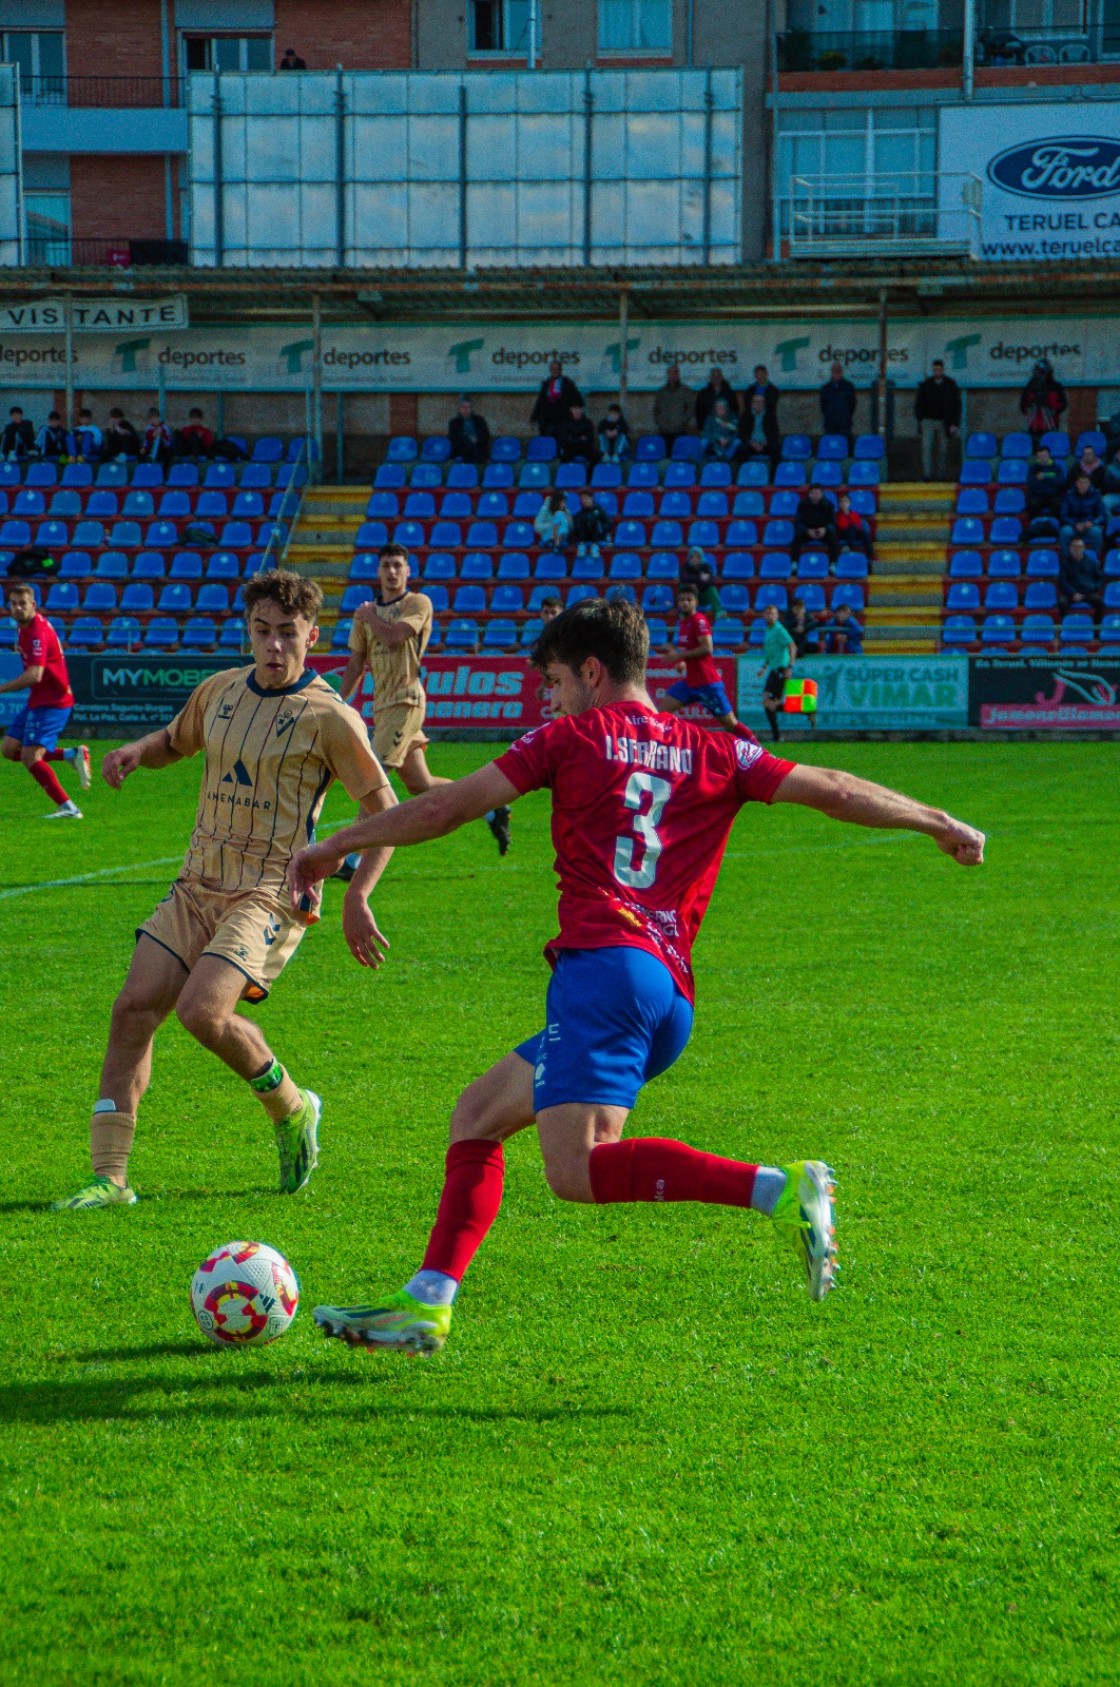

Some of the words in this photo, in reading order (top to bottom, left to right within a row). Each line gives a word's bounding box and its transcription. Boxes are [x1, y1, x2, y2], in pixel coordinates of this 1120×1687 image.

[1021, 146, 1120, 189] Ford
[1005, 213, 1089, 230] TERUEL
[8, 305, 175, 325] VISTANTE
[158, 347, 246, 369] deportes
[324, 347, 411, 368] deportes
[648, 345, 737, 367] deportes
[819, 344, 908, 367] depores
[909, 667, 959, 681] CASH
[850, 683, 957, 707] VIMAR
[605, 735, 693, 775] I.SERRANO
[613, 771, 672, 889] 3
